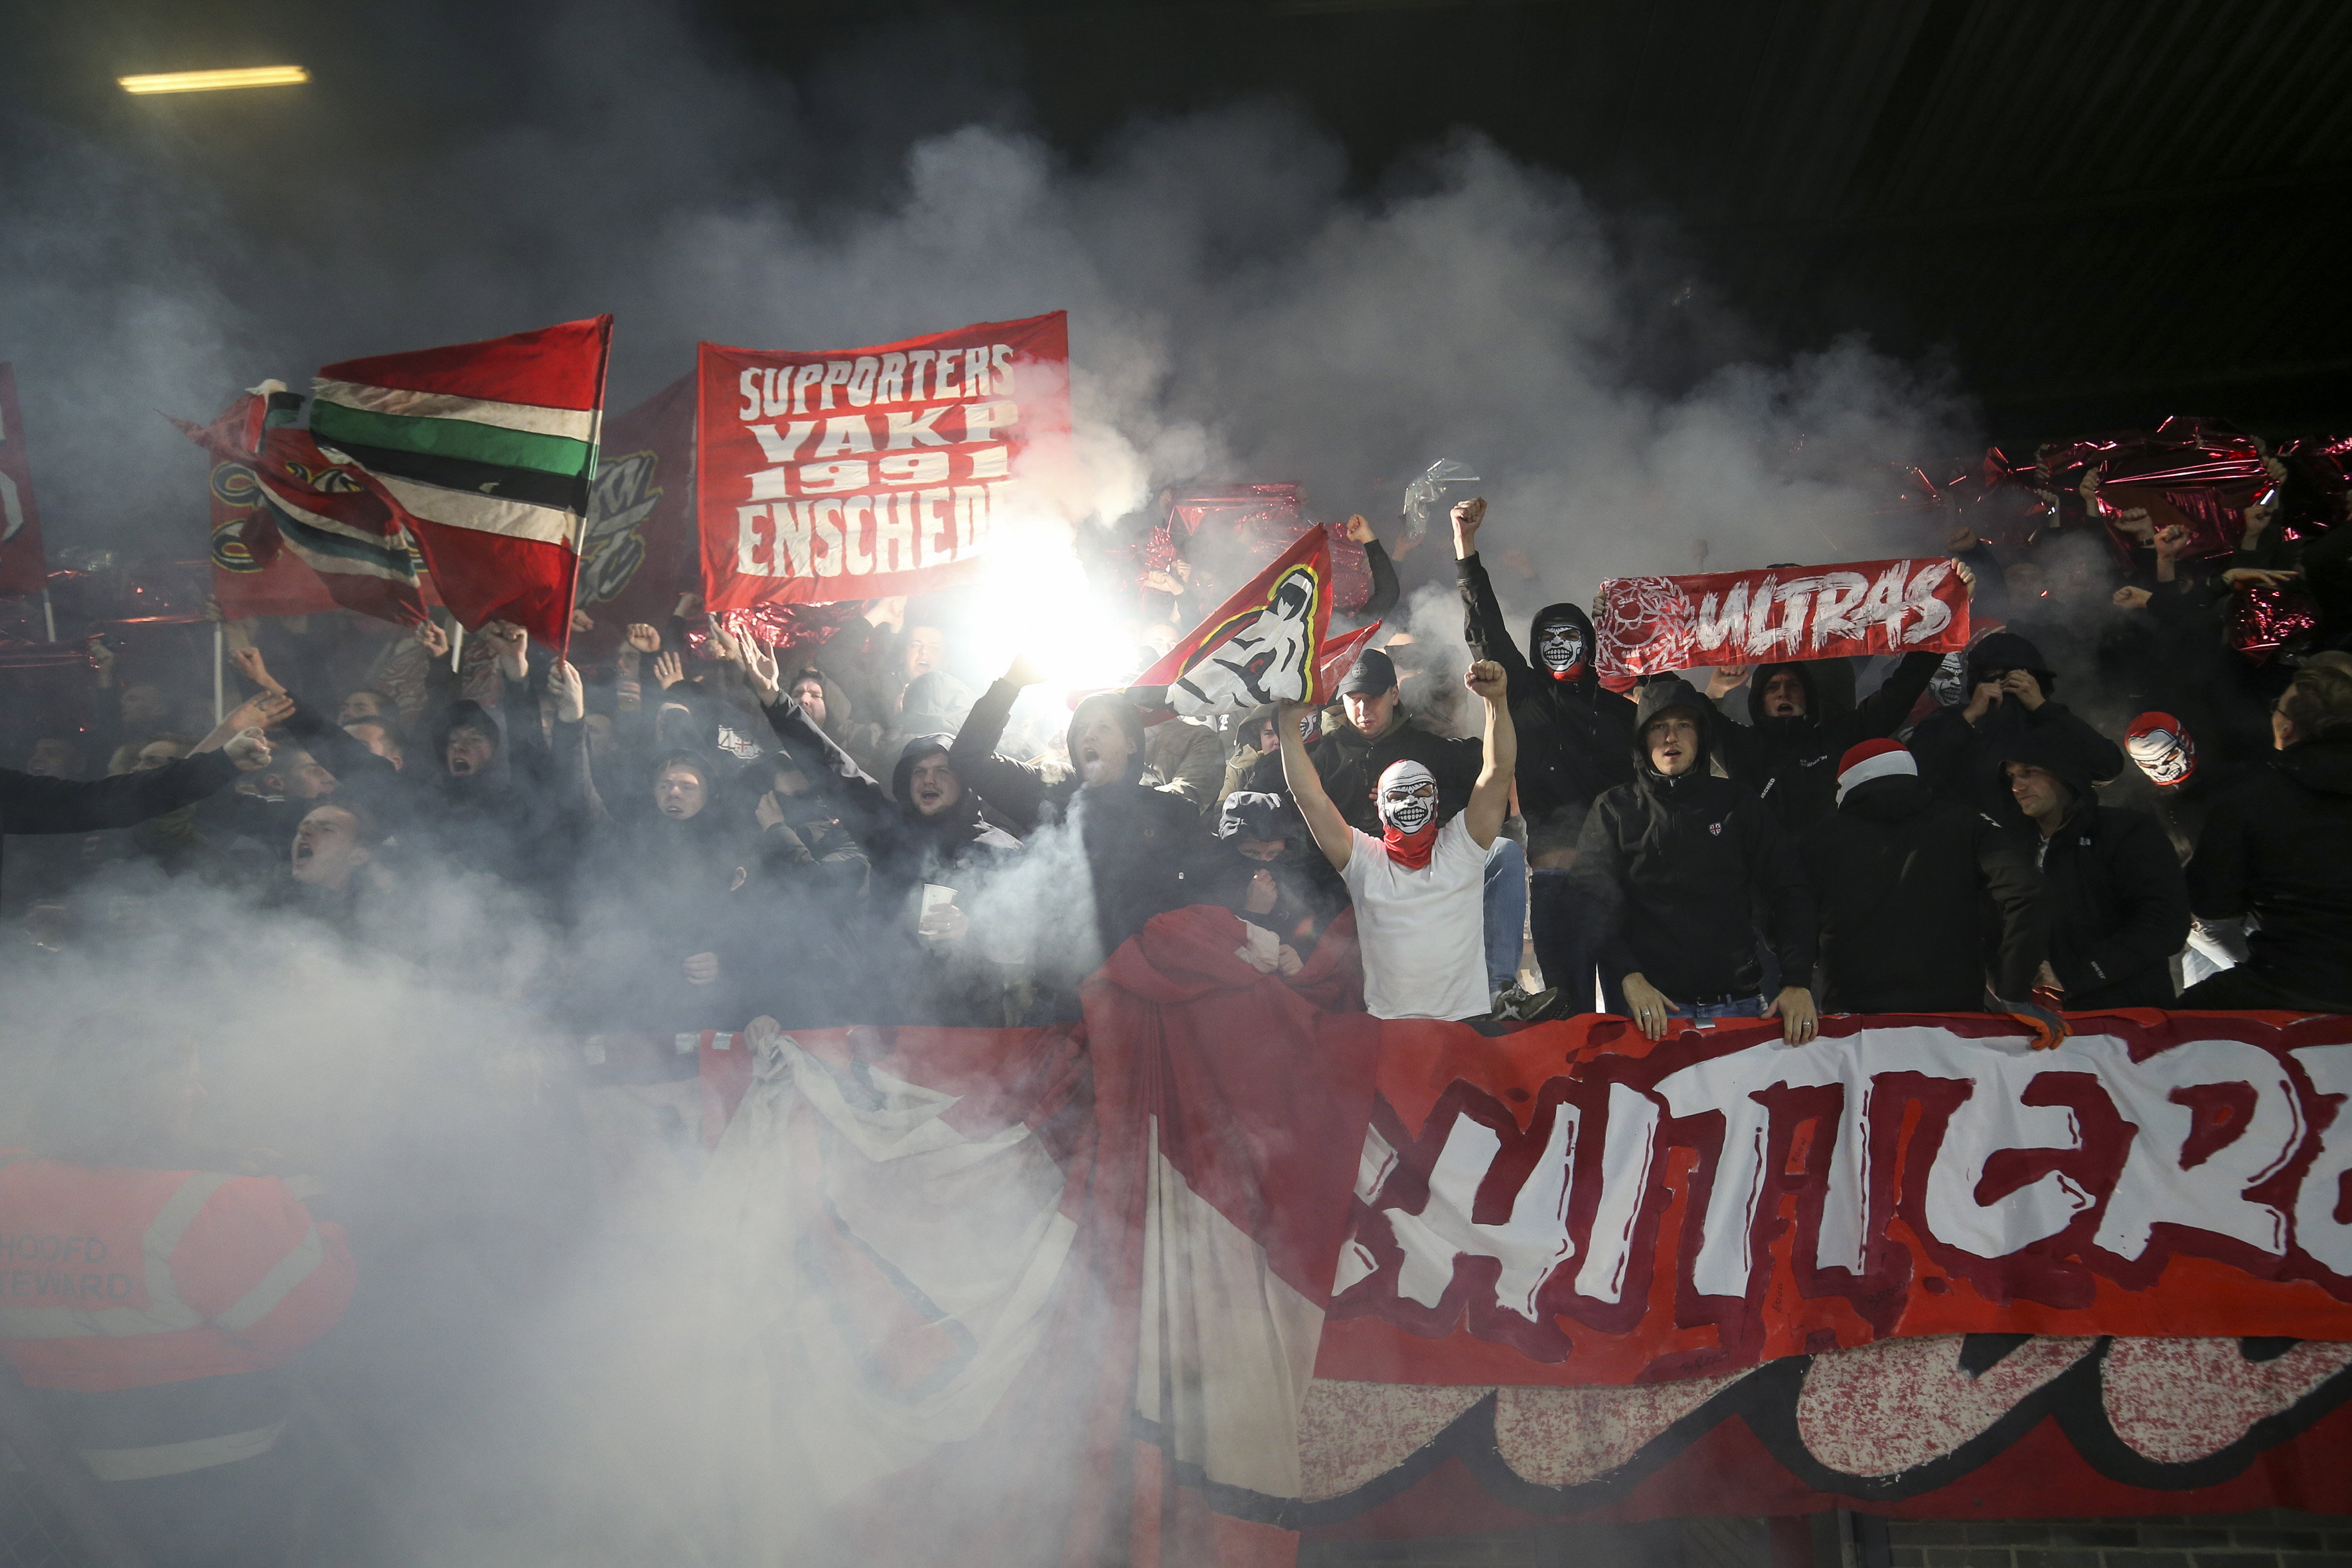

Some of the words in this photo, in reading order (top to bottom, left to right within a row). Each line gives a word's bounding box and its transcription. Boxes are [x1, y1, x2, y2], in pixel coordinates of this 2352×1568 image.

[739, 344, 1015, 421] SUPPORTERS
[743, 445, 1012, 501] 1991
[1697, 560, 1952, 657] ULTRAS
